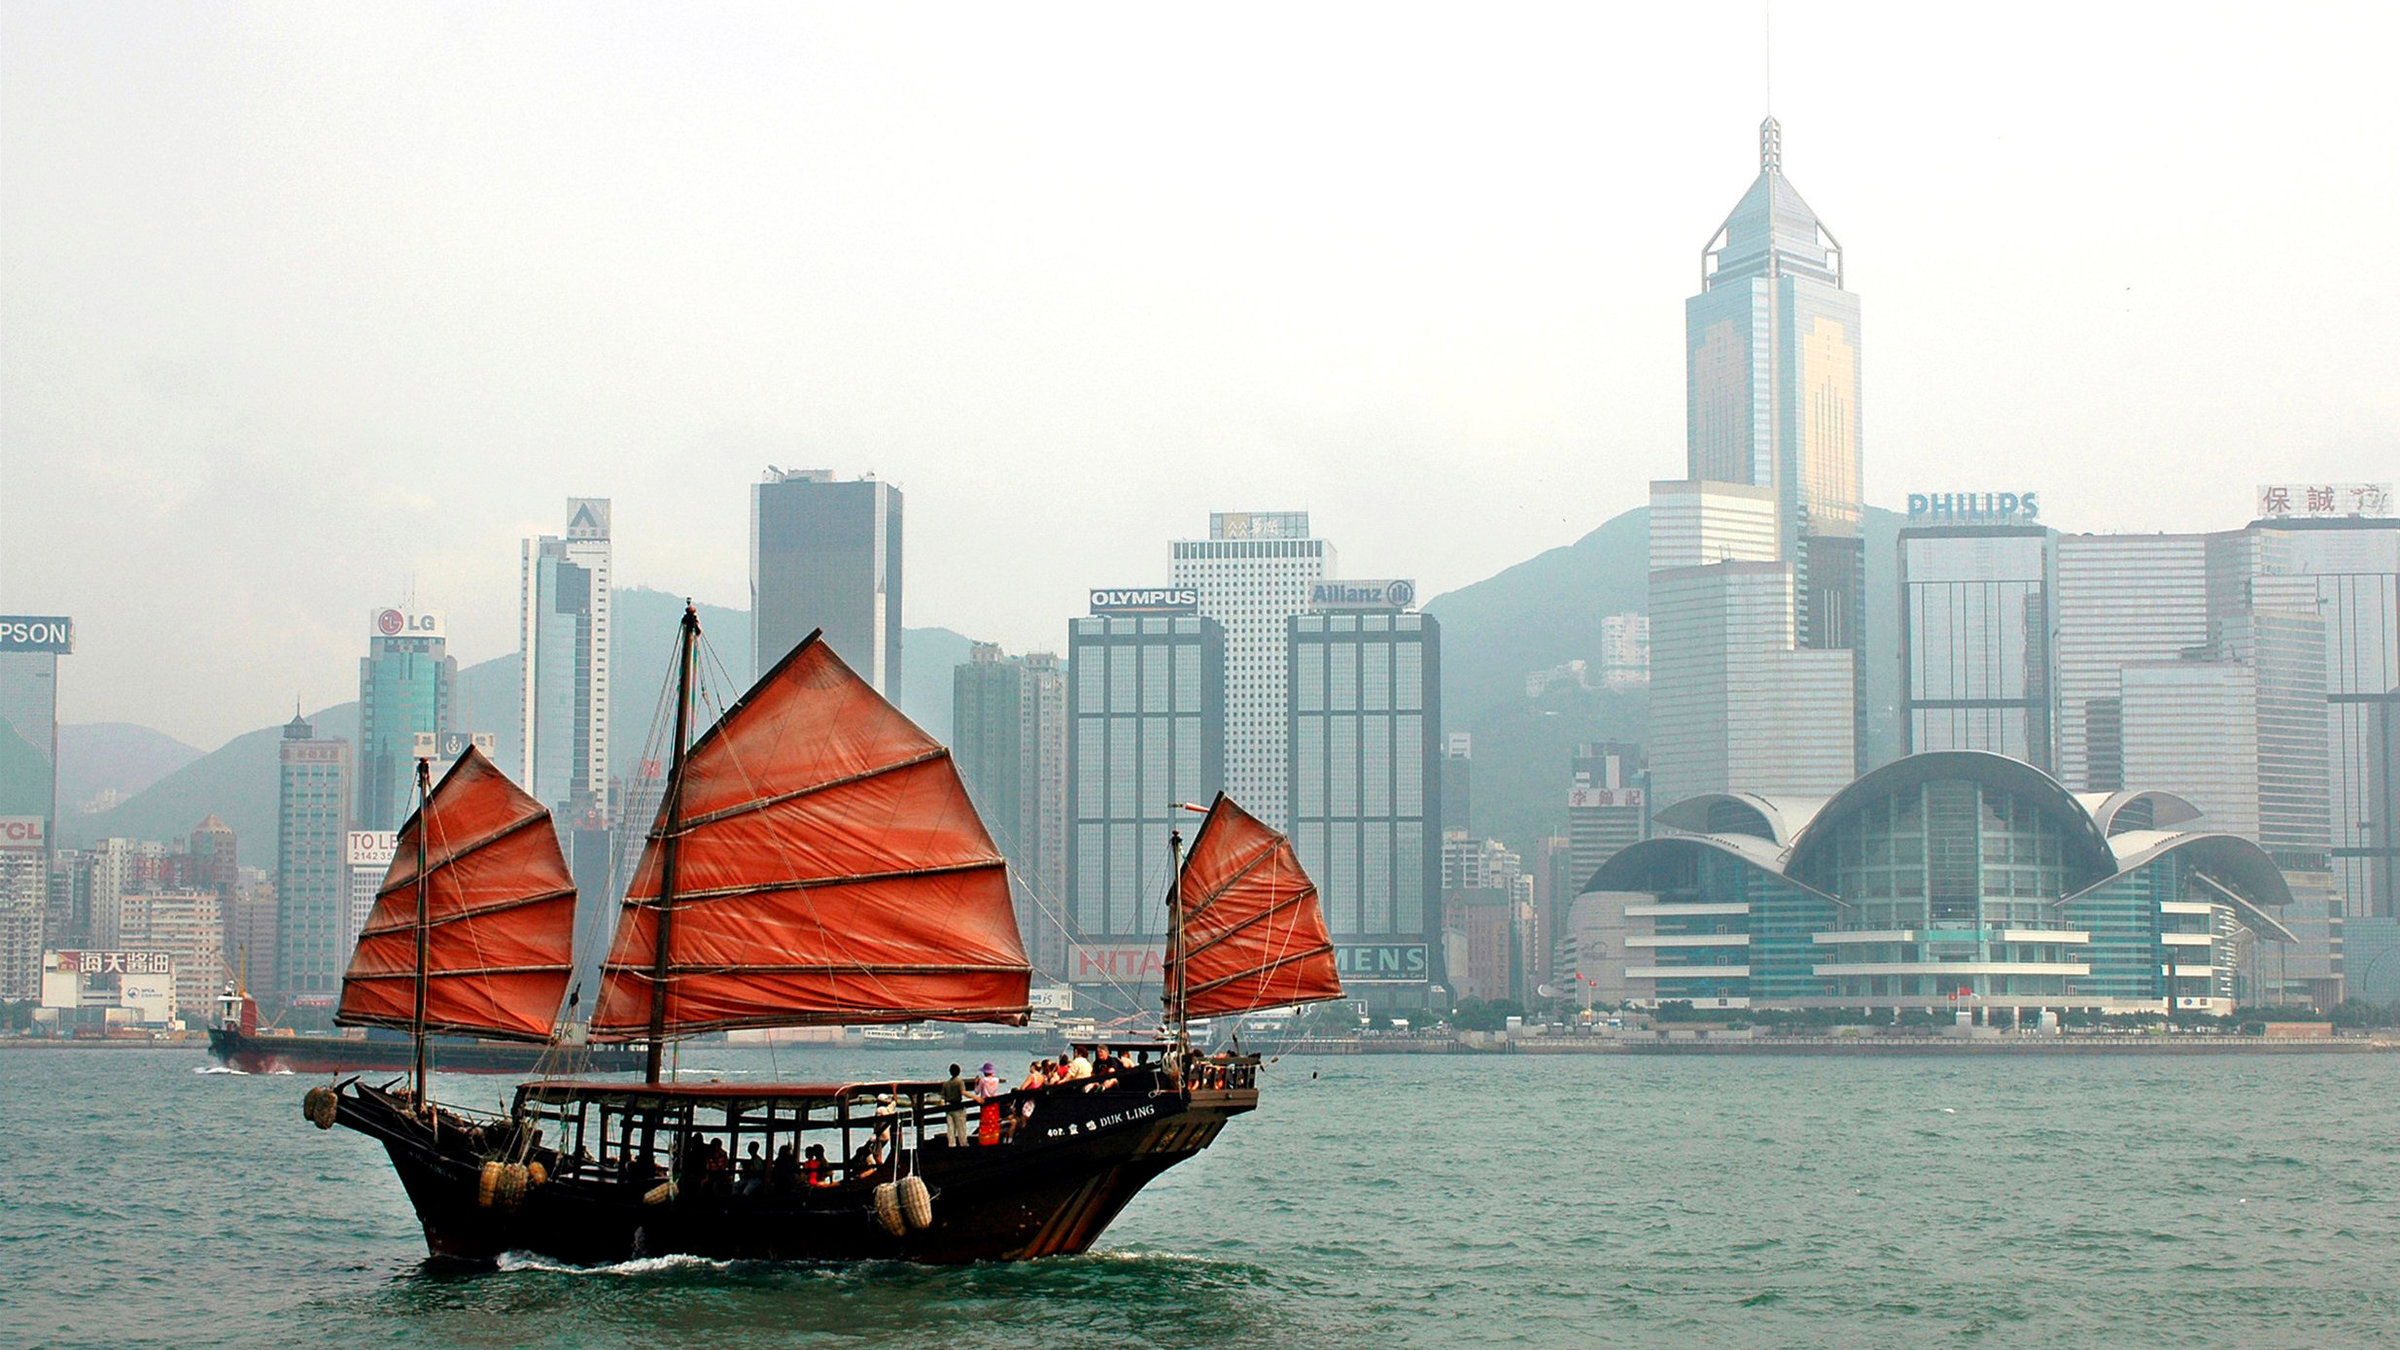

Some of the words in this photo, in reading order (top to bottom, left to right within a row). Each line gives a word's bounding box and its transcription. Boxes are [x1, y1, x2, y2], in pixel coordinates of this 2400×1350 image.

[1907, 491, 2039, 520] PHILIPS
[2262, 485, 2335, 513] 保誠
[1091, 590, 1197, 605] OLYMPUS
[1313, 584, 1382, 602] Allianz
[408, 614, 435, 631] LG
[350, 833, 375, 850] TO
[1099, 1112, 1123, 1128] DUK
[1125, 1103, 1155, 1121] LING
